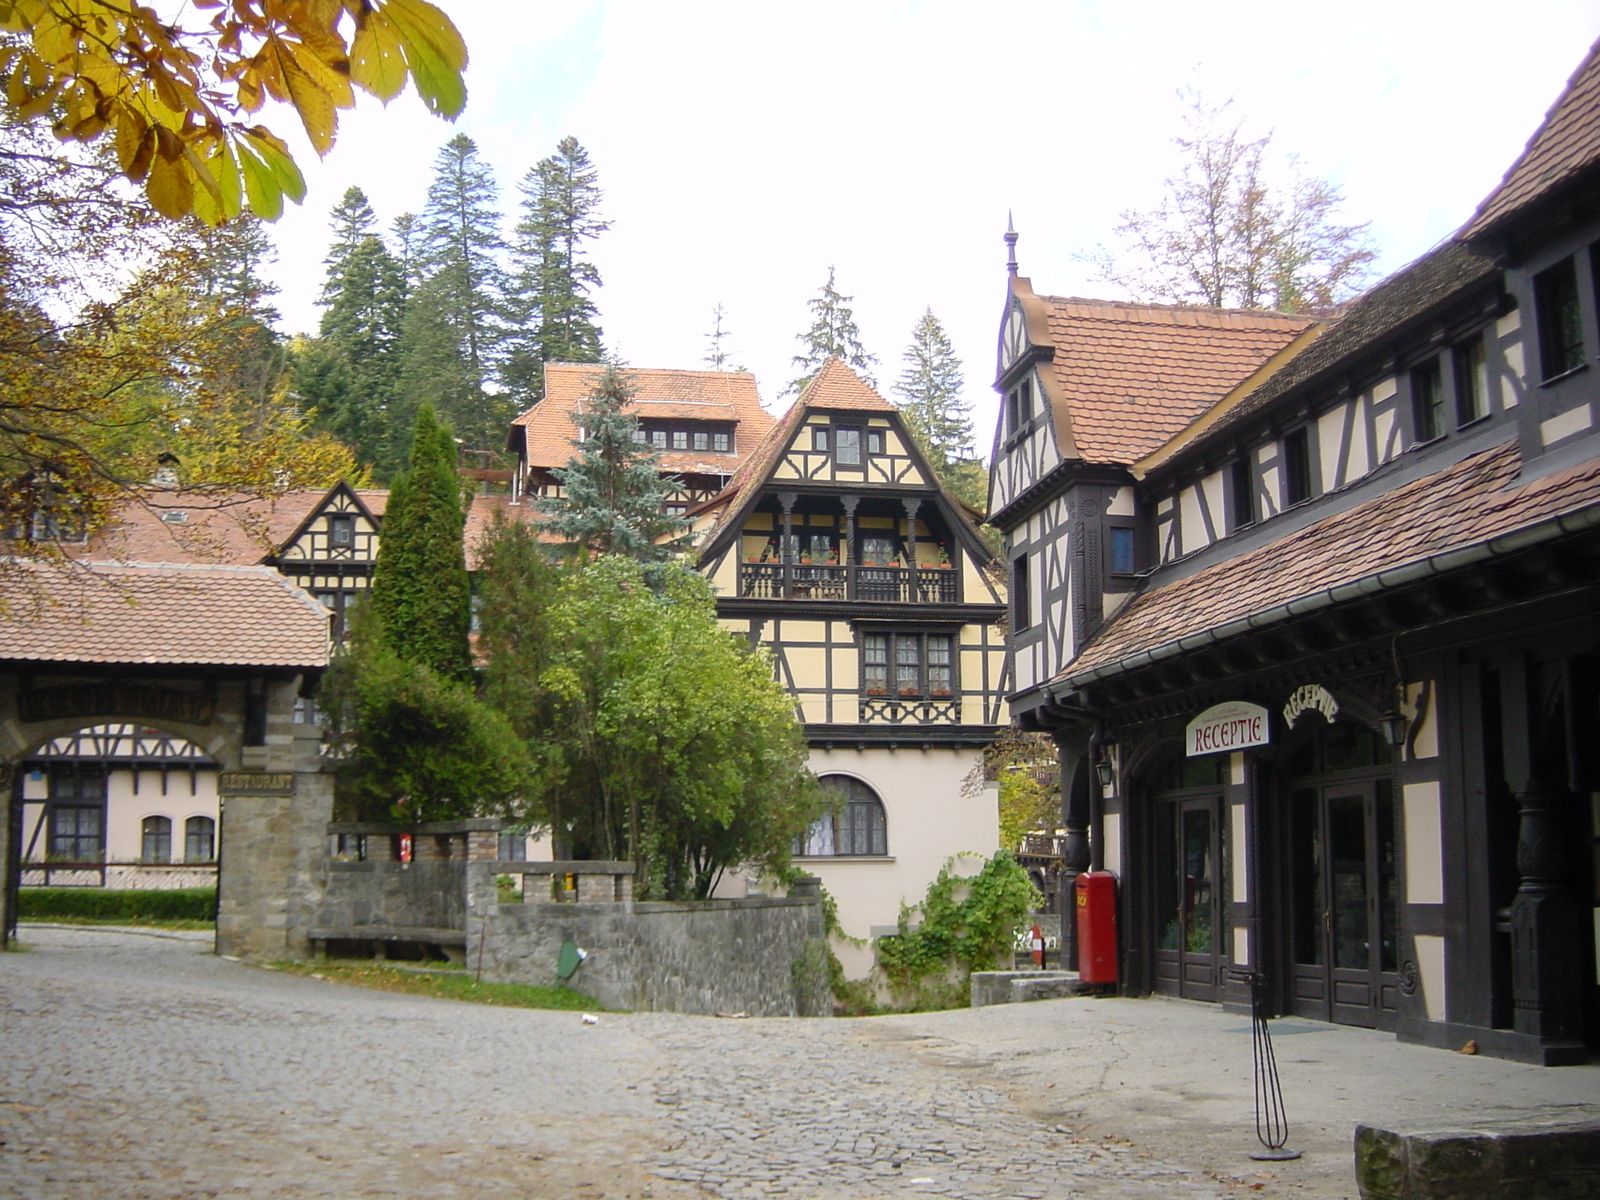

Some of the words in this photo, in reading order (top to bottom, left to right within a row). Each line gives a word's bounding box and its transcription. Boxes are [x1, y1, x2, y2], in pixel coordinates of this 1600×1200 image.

[1283, 683, 1340, 730] RECEPTIE
[1194, 716, 1261, 752] RECEPTIE
[221, 773, 292, 790] RESTAURANT
